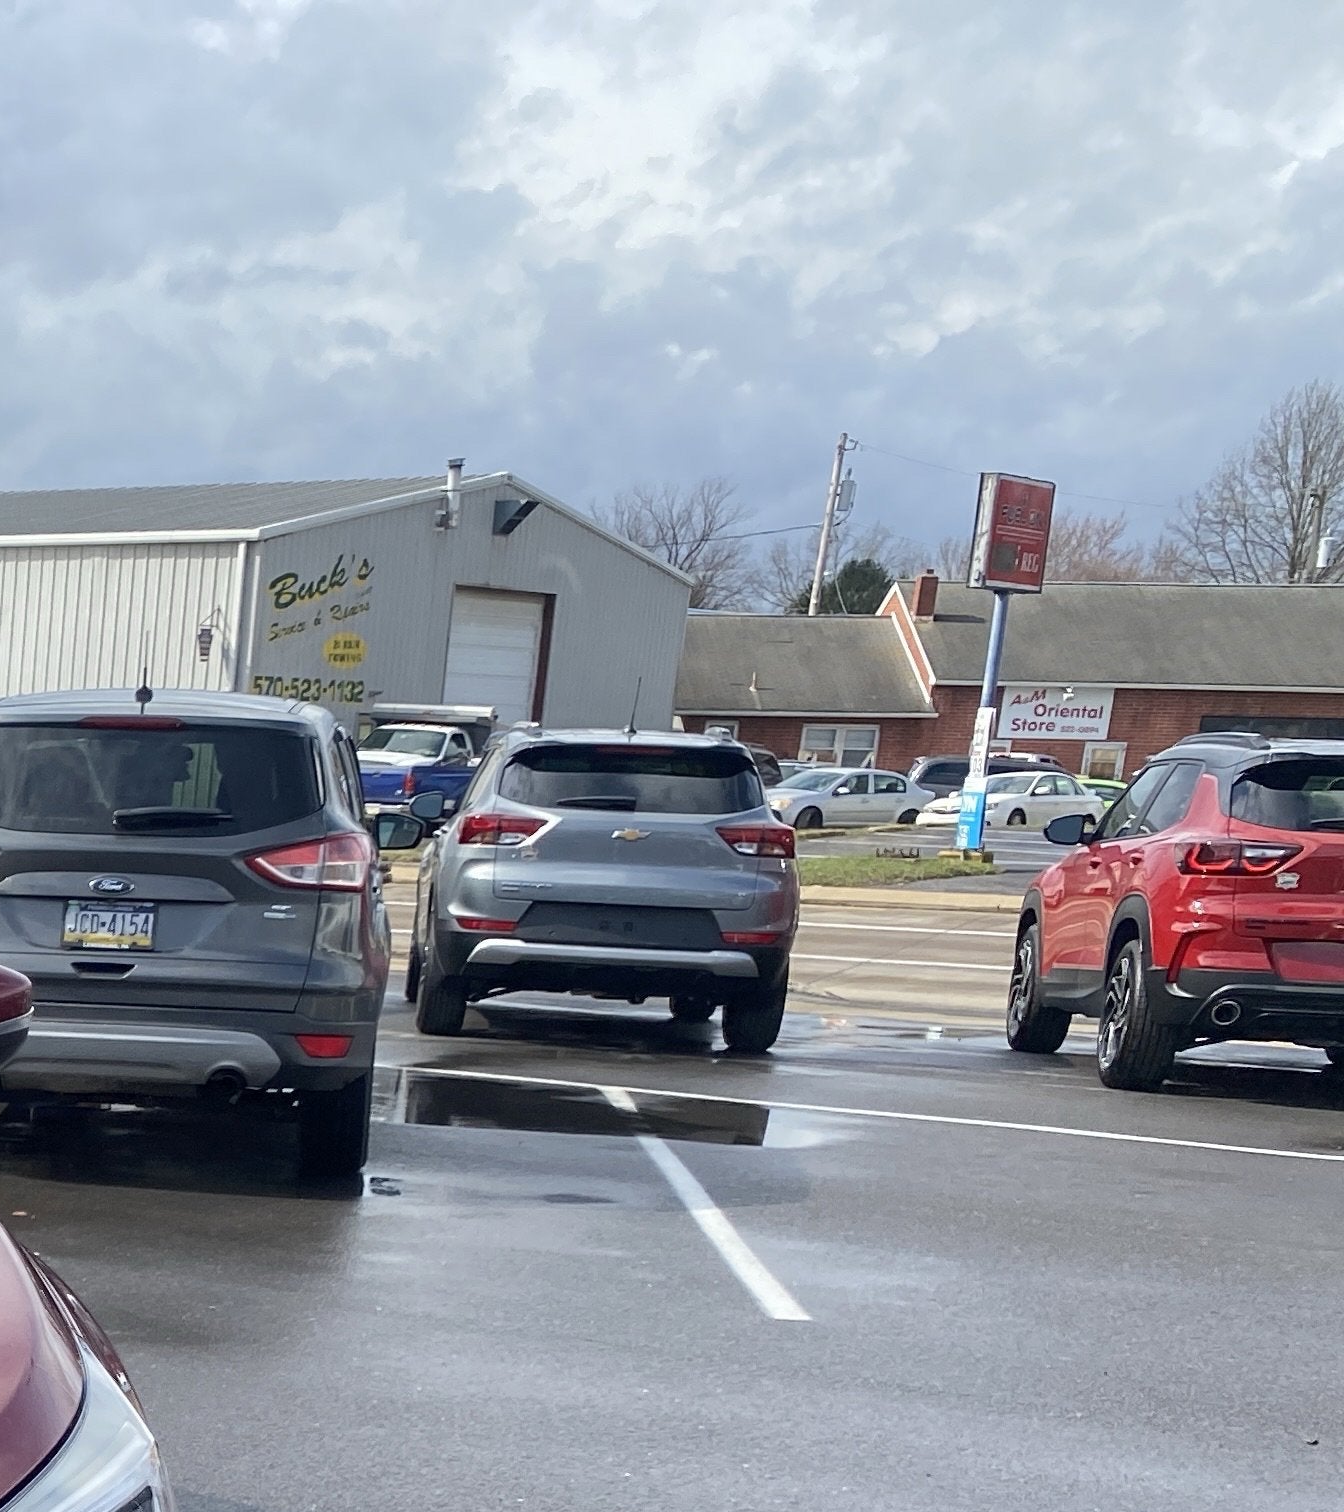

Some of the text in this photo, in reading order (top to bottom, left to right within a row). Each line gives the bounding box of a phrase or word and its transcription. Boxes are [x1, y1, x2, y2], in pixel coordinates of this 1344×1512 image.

[268, 554, 374, 609] Buck's
[1034, 703, 1104, 719] Oriental
[1011, 717, 1056, 732] Store
